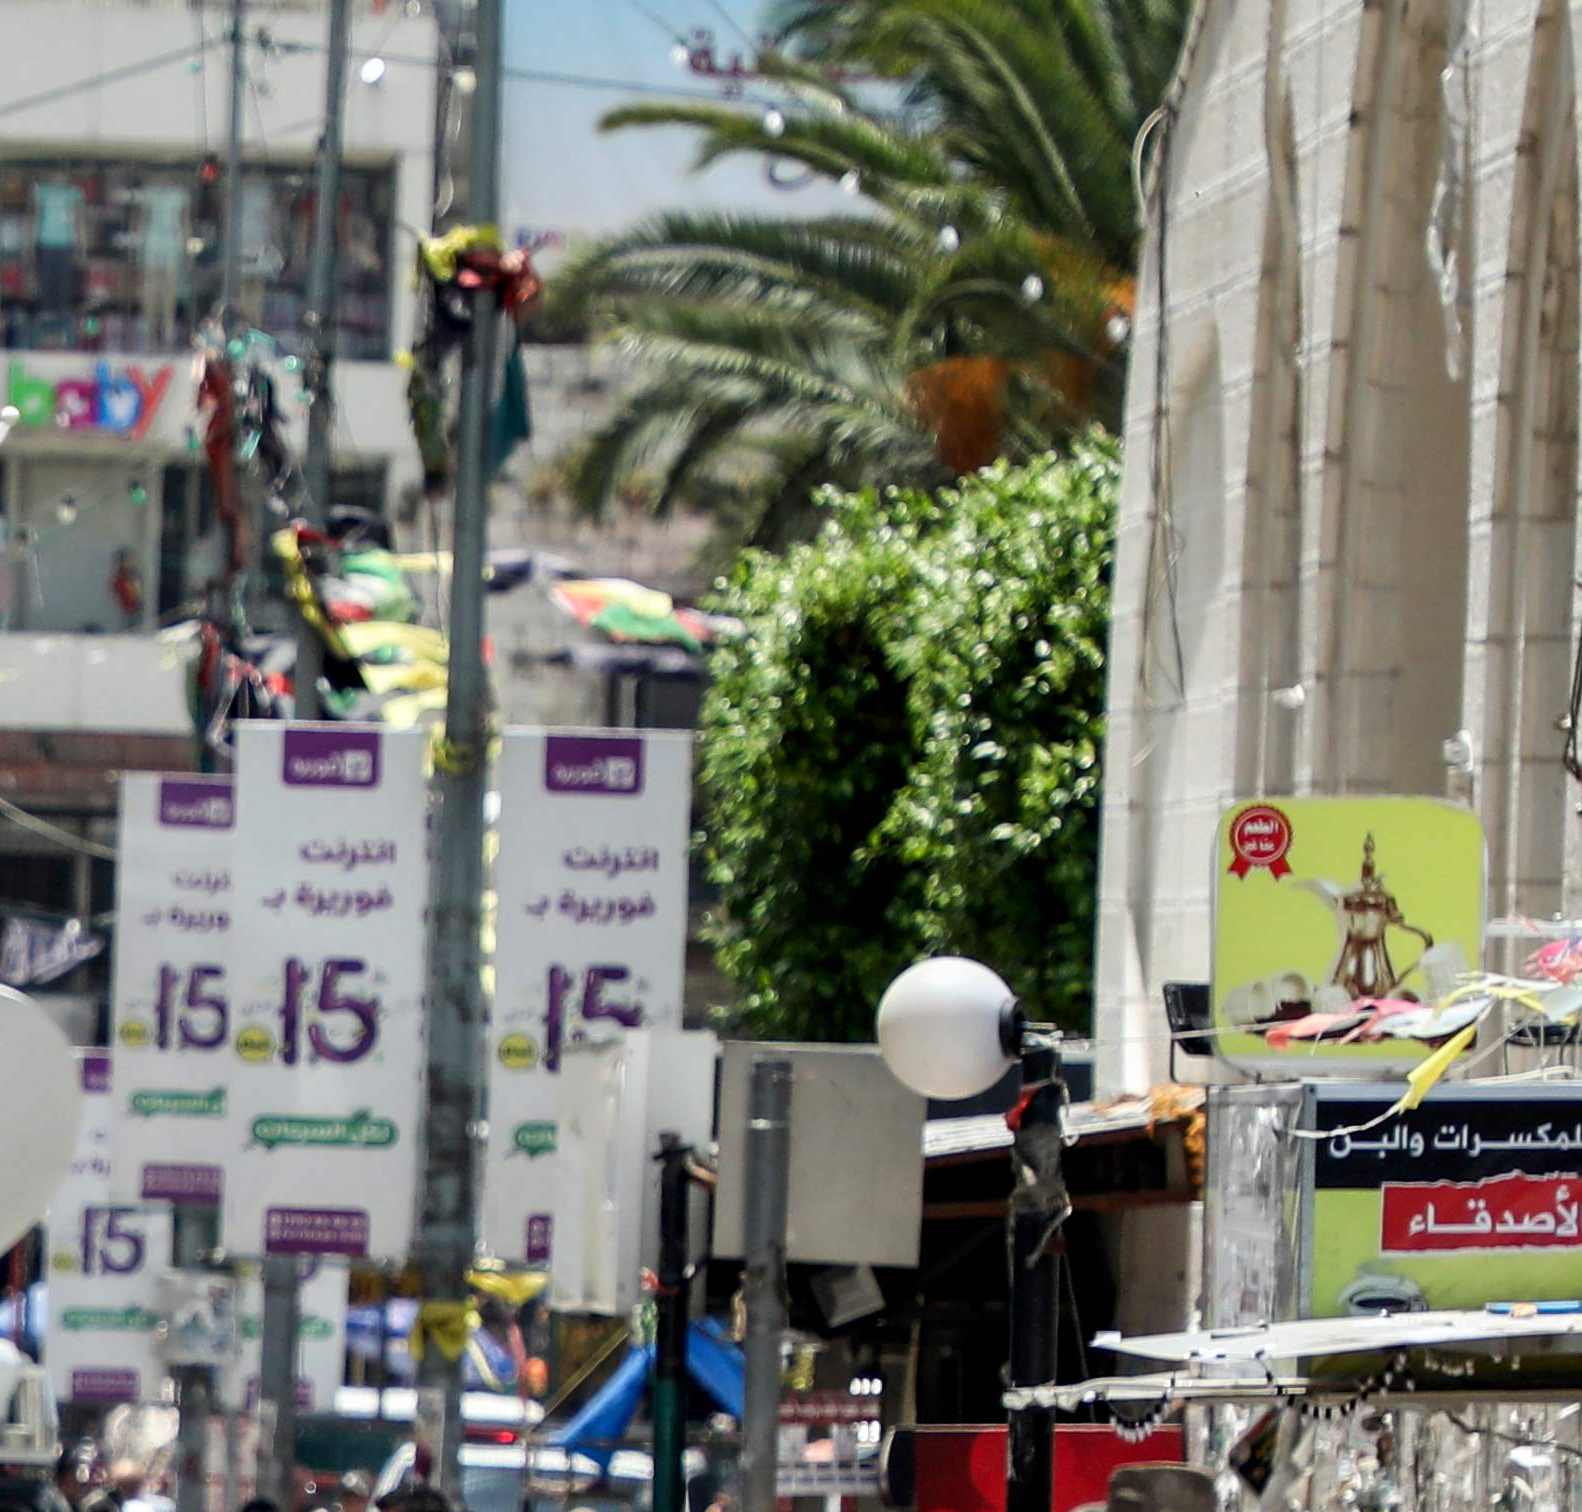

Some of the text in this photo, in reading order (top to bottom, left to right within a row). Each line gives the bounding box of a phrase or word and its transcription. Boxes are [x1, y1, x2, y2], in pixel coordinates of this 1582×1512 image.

[9, 356, 174, 440] baby
[155, 963, 227, 1050] 15
[282, 957, 377, 1064] 15
[81, 1206, 145, 1275] 15
